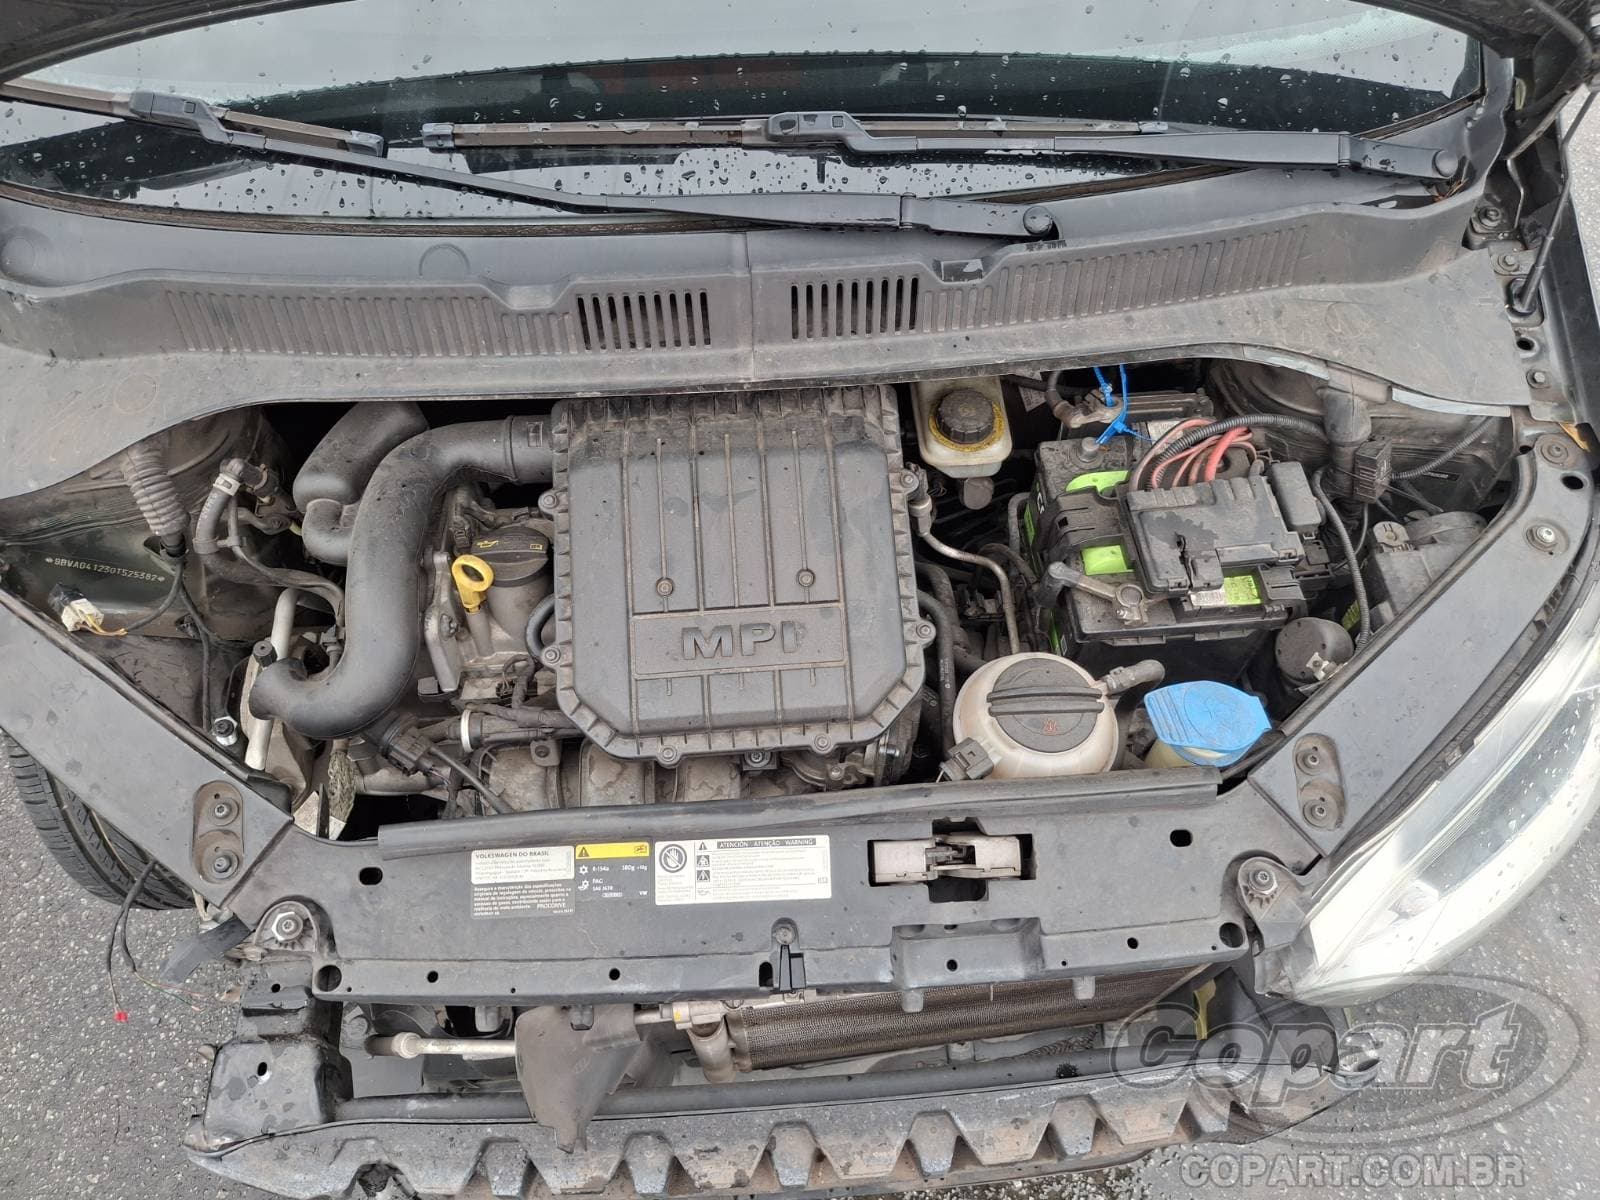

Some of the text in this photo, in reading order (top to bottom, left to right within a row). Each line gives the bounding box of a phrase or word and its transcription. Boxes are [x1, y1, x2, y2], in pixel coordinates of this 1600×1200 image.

[681, 620, 796, 661] MPI
[753, 839, 781, 848] ATENÇÃO
[785, 838, 814, 846] WARNING
